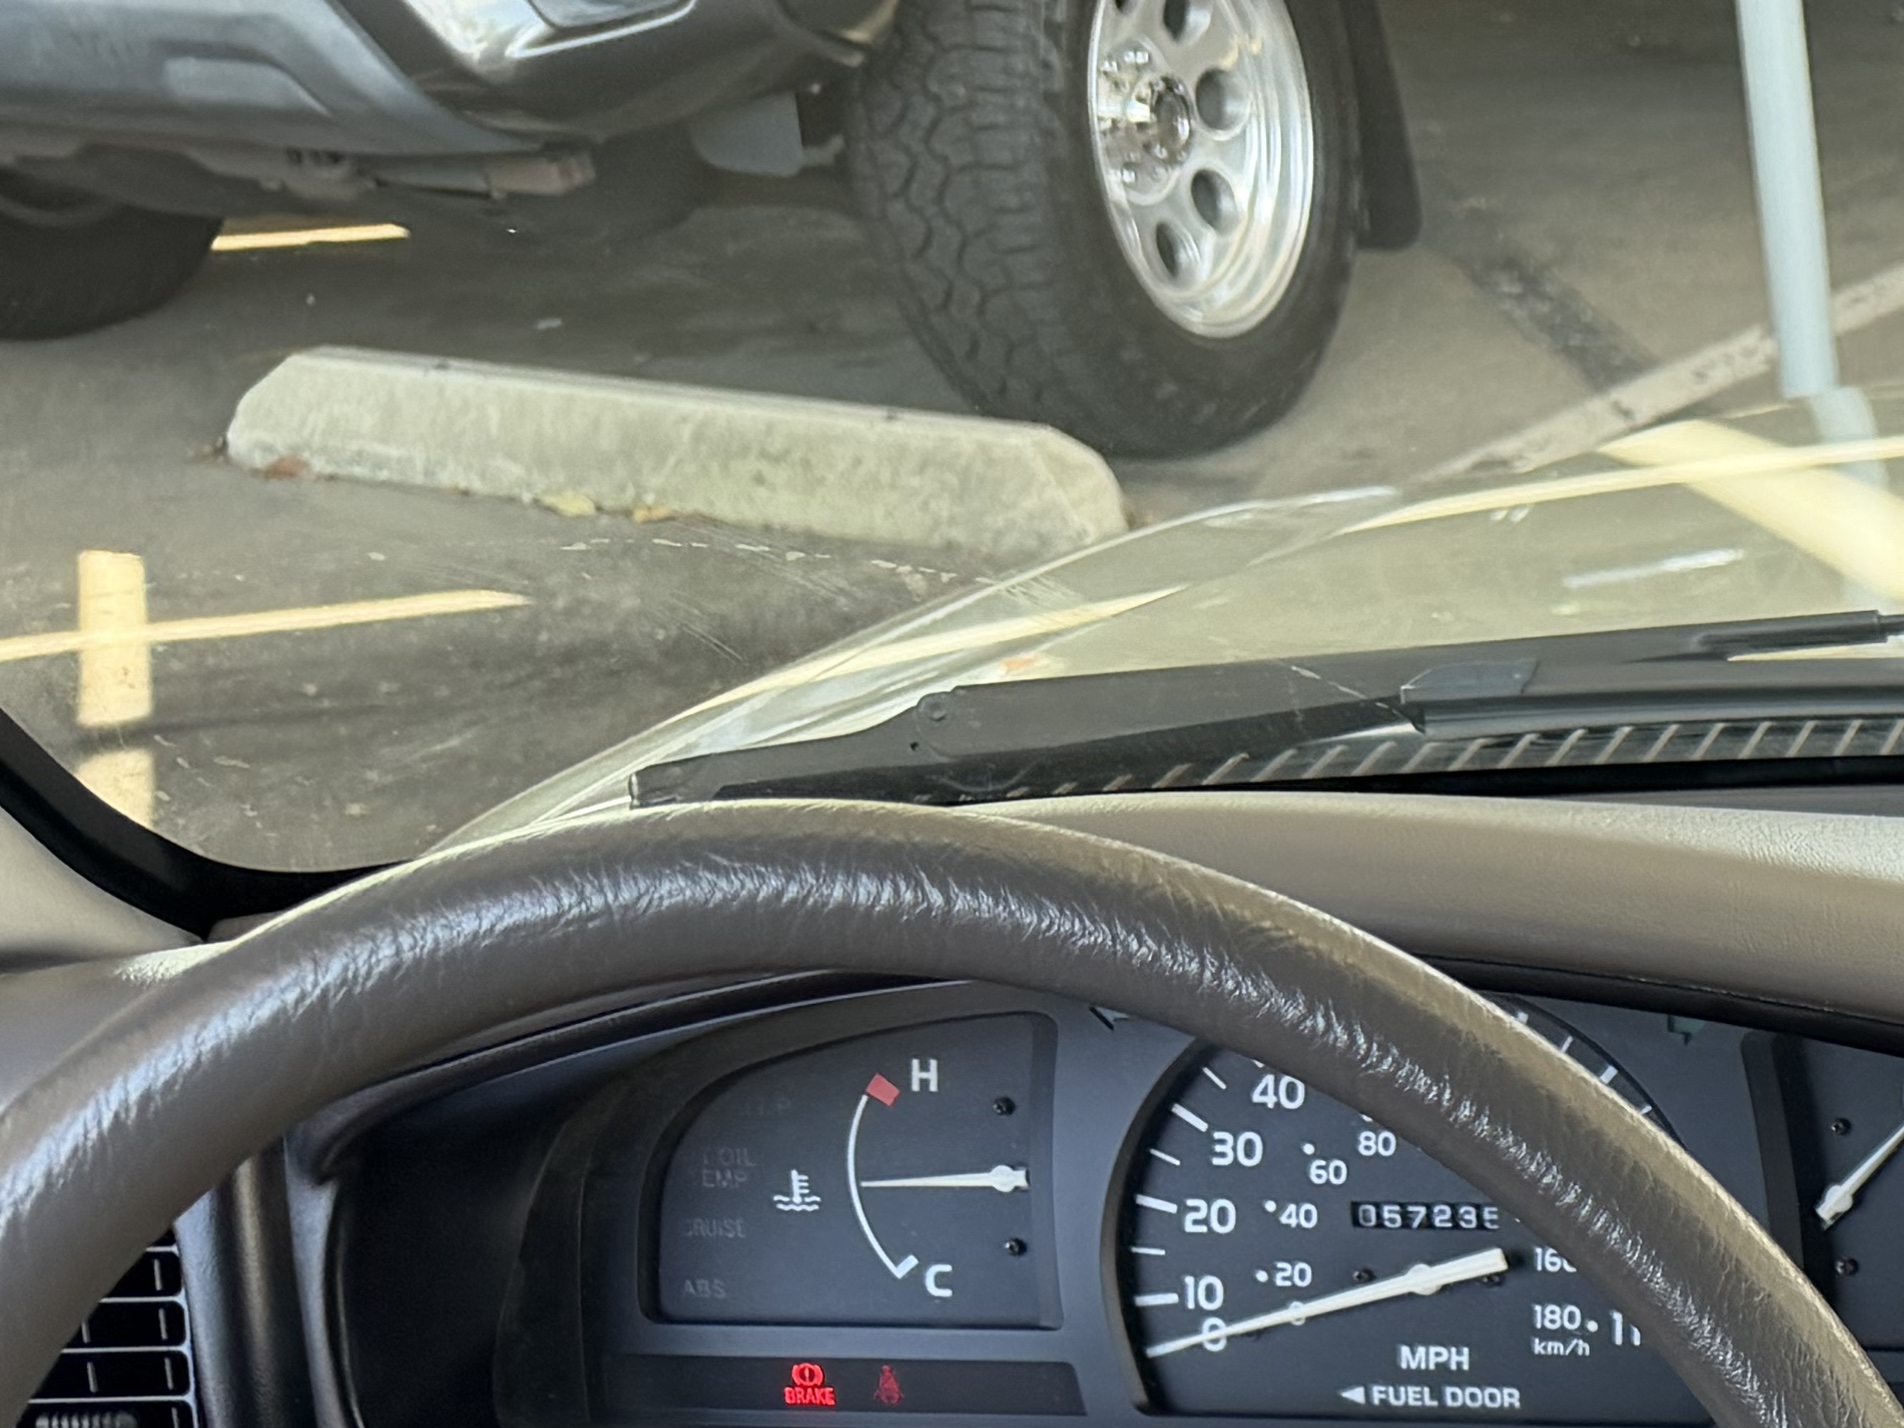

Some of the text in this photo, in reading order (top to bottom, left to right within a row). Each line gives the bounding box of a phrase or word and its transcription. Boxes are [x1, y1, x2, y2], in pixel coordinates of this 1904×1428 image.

[909, 1058, 940, 1093] H
[1251, 1074, 1306, 1110] 40
[1211, 1131, 1264, 1168] 30
[1356, 1130, 1398, 1157] 80
[1307, 1159, 1349, 1186] 60
[1183, 1199, 1237, 1234] 20
[1278, 1203, 1319, 1230] 40
[924, 1264, 954, 1298] C
[1274, 1262, 1314, 1288] 20
[1183, 1275, 1225, 1311] 10
[1533, 1304, 1582, 1331] 180
[1400, 1345, 1470, 1372] MPH
[1533, 1337, 1591, 1357] km/h
[784, 1385, 836, 1406] BRAKE
[1371, 1385, 1522, 1410] FUEL DOOR
